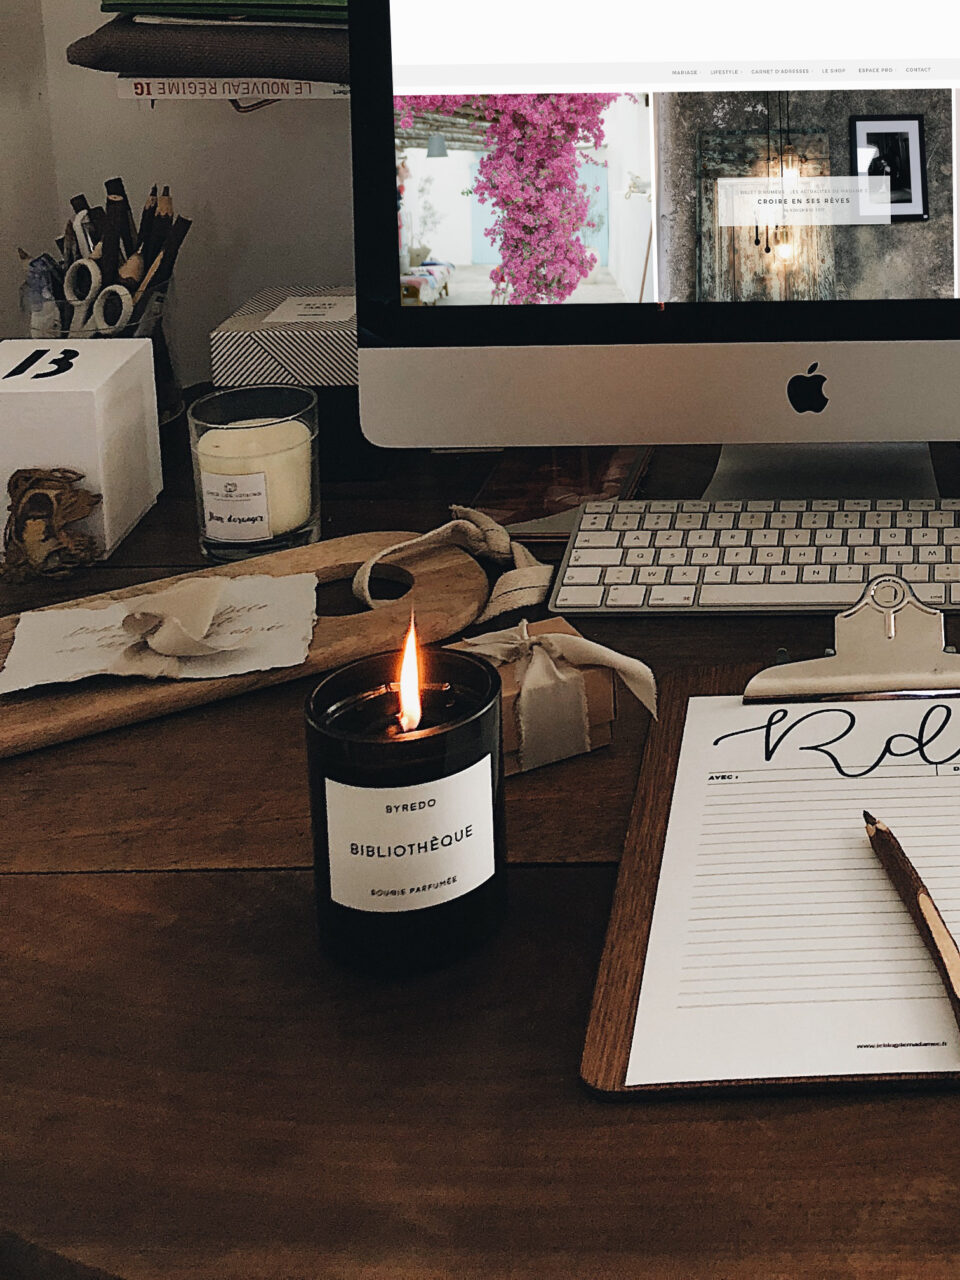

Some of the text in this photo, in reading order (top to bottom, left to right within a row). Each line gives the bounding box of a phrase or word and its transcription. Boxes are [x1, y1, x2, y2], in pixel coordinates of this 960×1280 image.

[133, 81, 313, 98] LE NOUVEAU RÉGIME IG
[791, 197, 803, 205] EN
[824, 195, 851, 204] RÊVES
[1, 348, 80, 380] 13
[385, 798, 437, 814] BYREDO
[350, 824, 474, 858] BIBLIOTHÈQUE
[409, 875, 458, 895] PARFUMÉE
